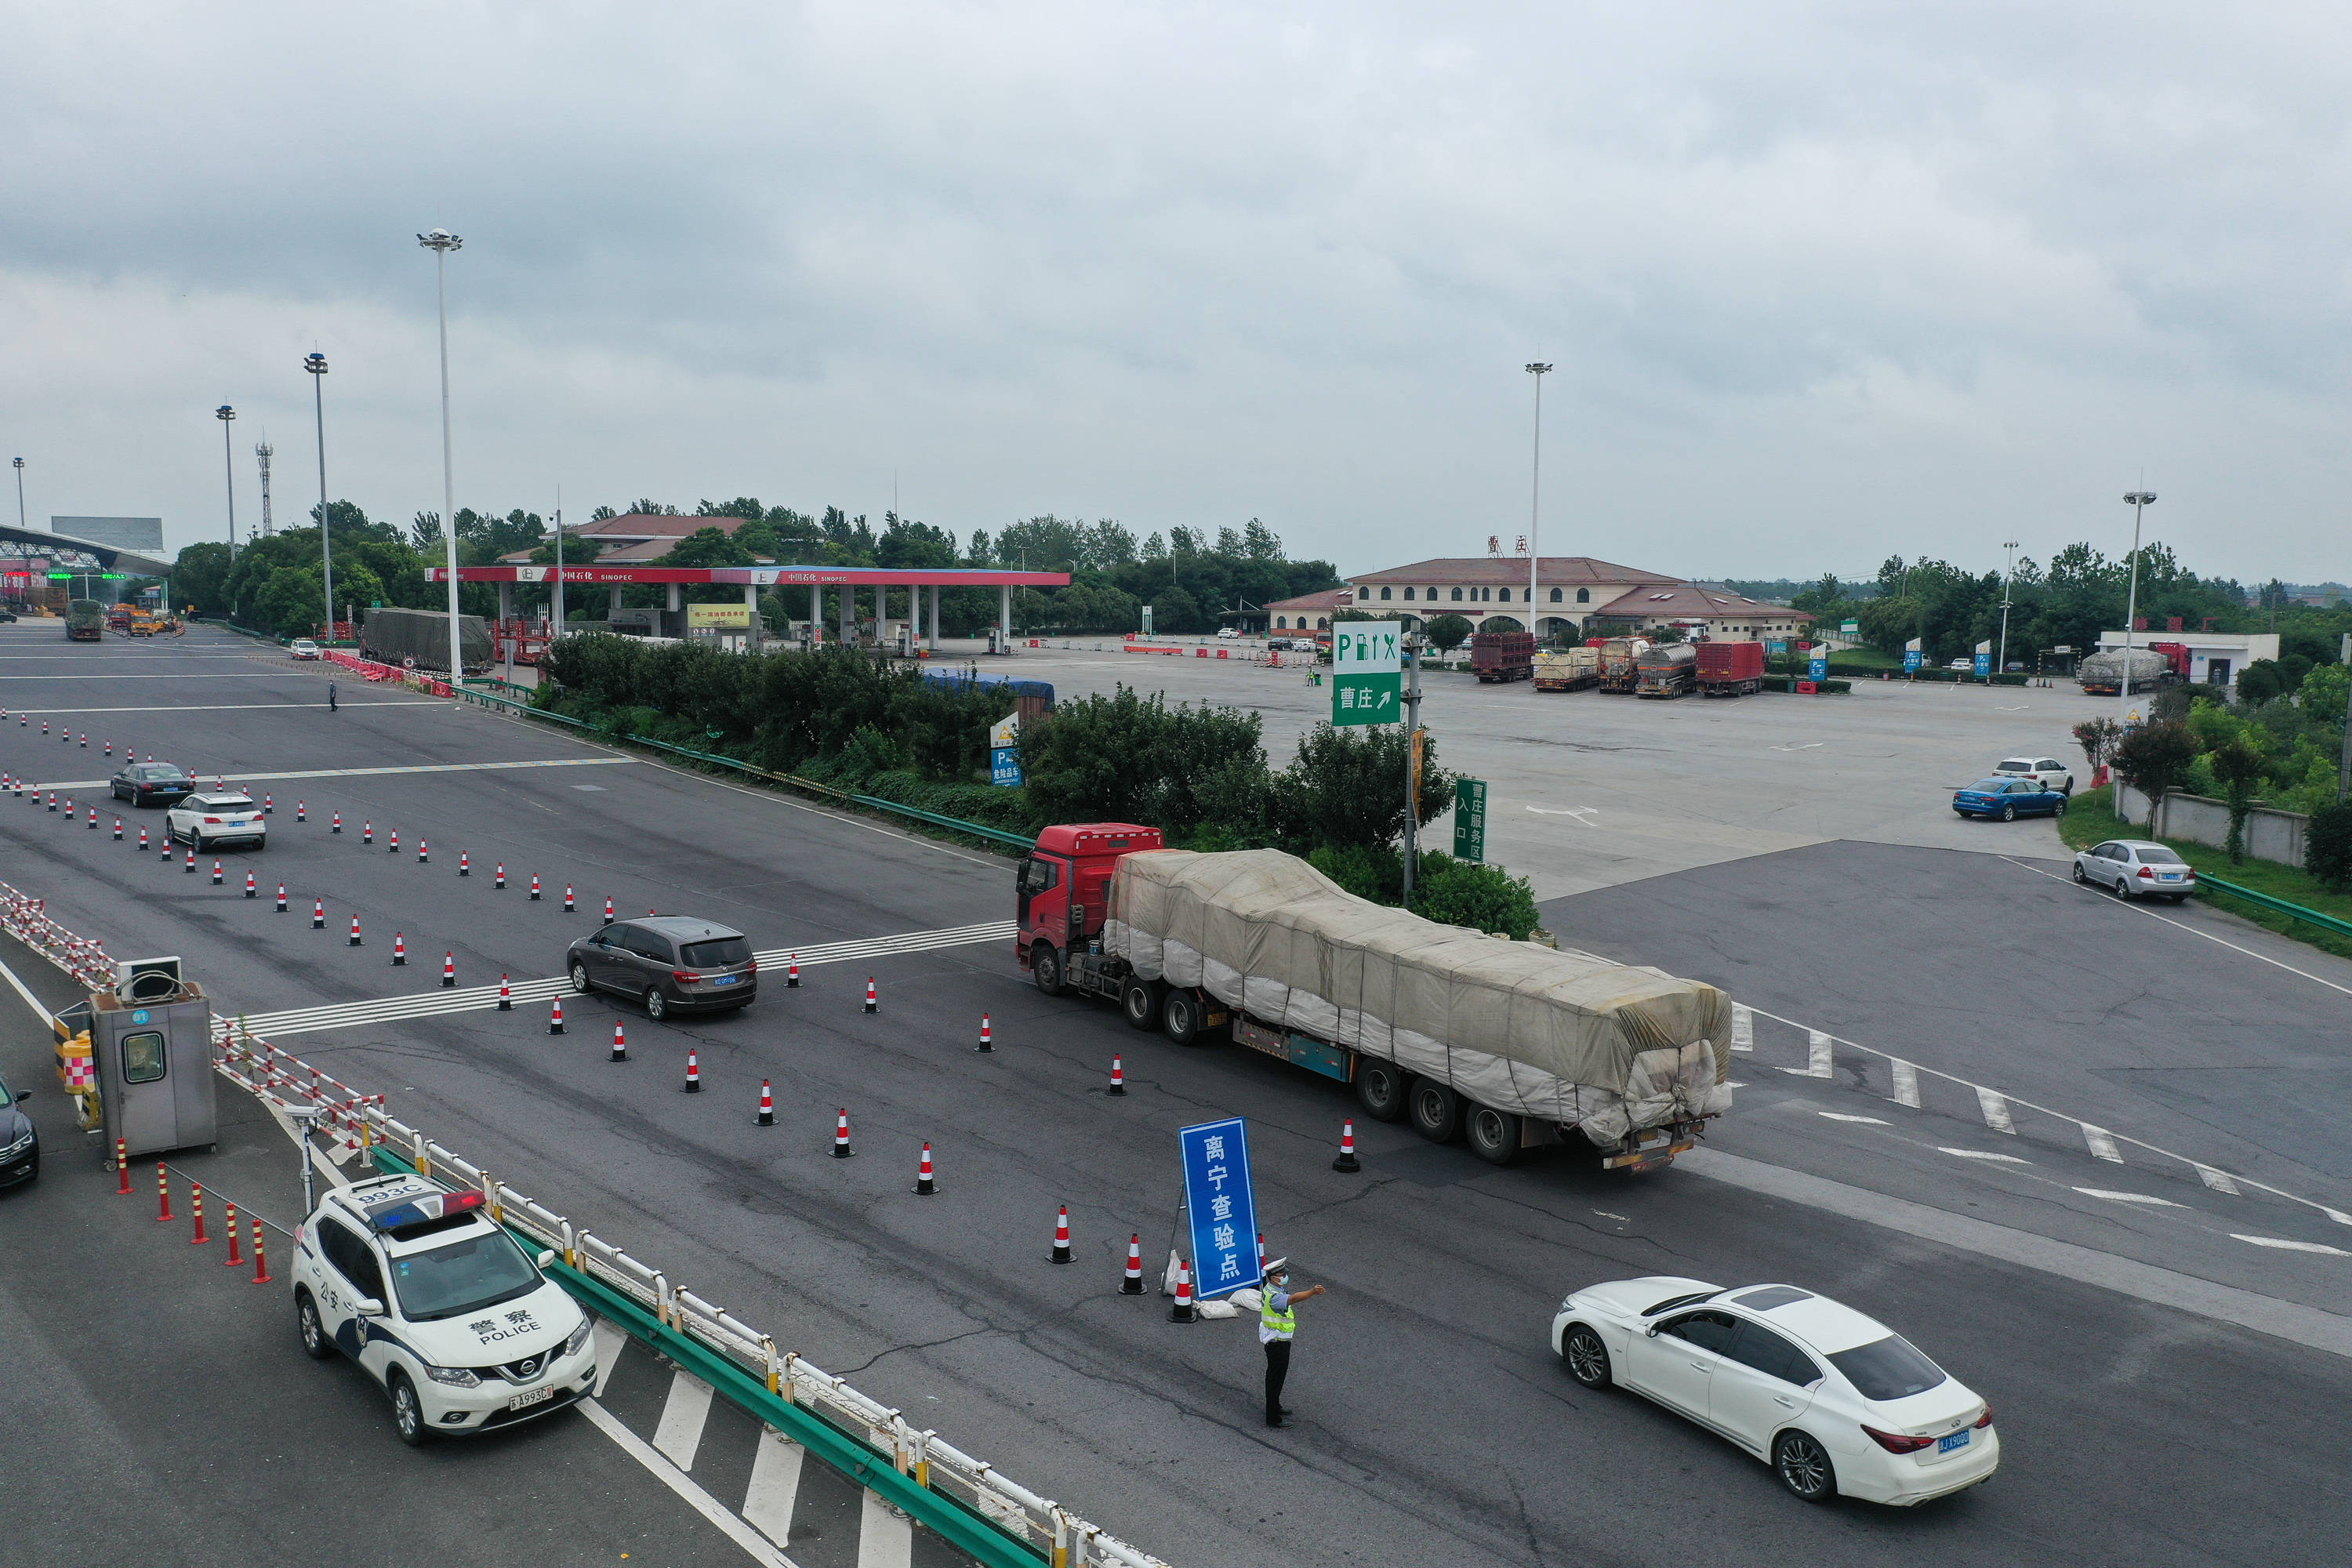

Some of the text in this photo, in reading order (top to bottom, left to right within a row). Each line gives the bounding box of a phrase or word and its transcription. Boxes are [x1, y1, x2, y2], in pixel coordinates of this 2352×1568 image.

[788, 573, 817, 582] 中国石化
[1338, 633, 1351, 661] P
[1339, 686, 1374, 710] 曹庄
[998, 752, 1006, 765] P
[1456, 797, 1469, 840] 入口
[1470, 783, 1483, 858] 曹庄服务区
[358, 1185, 423, 1203] 993C
[1203, 1134, 1241, 1281] 离宁查验点
[321, 1280, 339, 1313] 公安
[468, 1309, 533, 1335] 警察
[479, 1321, 542, 1345] POLICE
